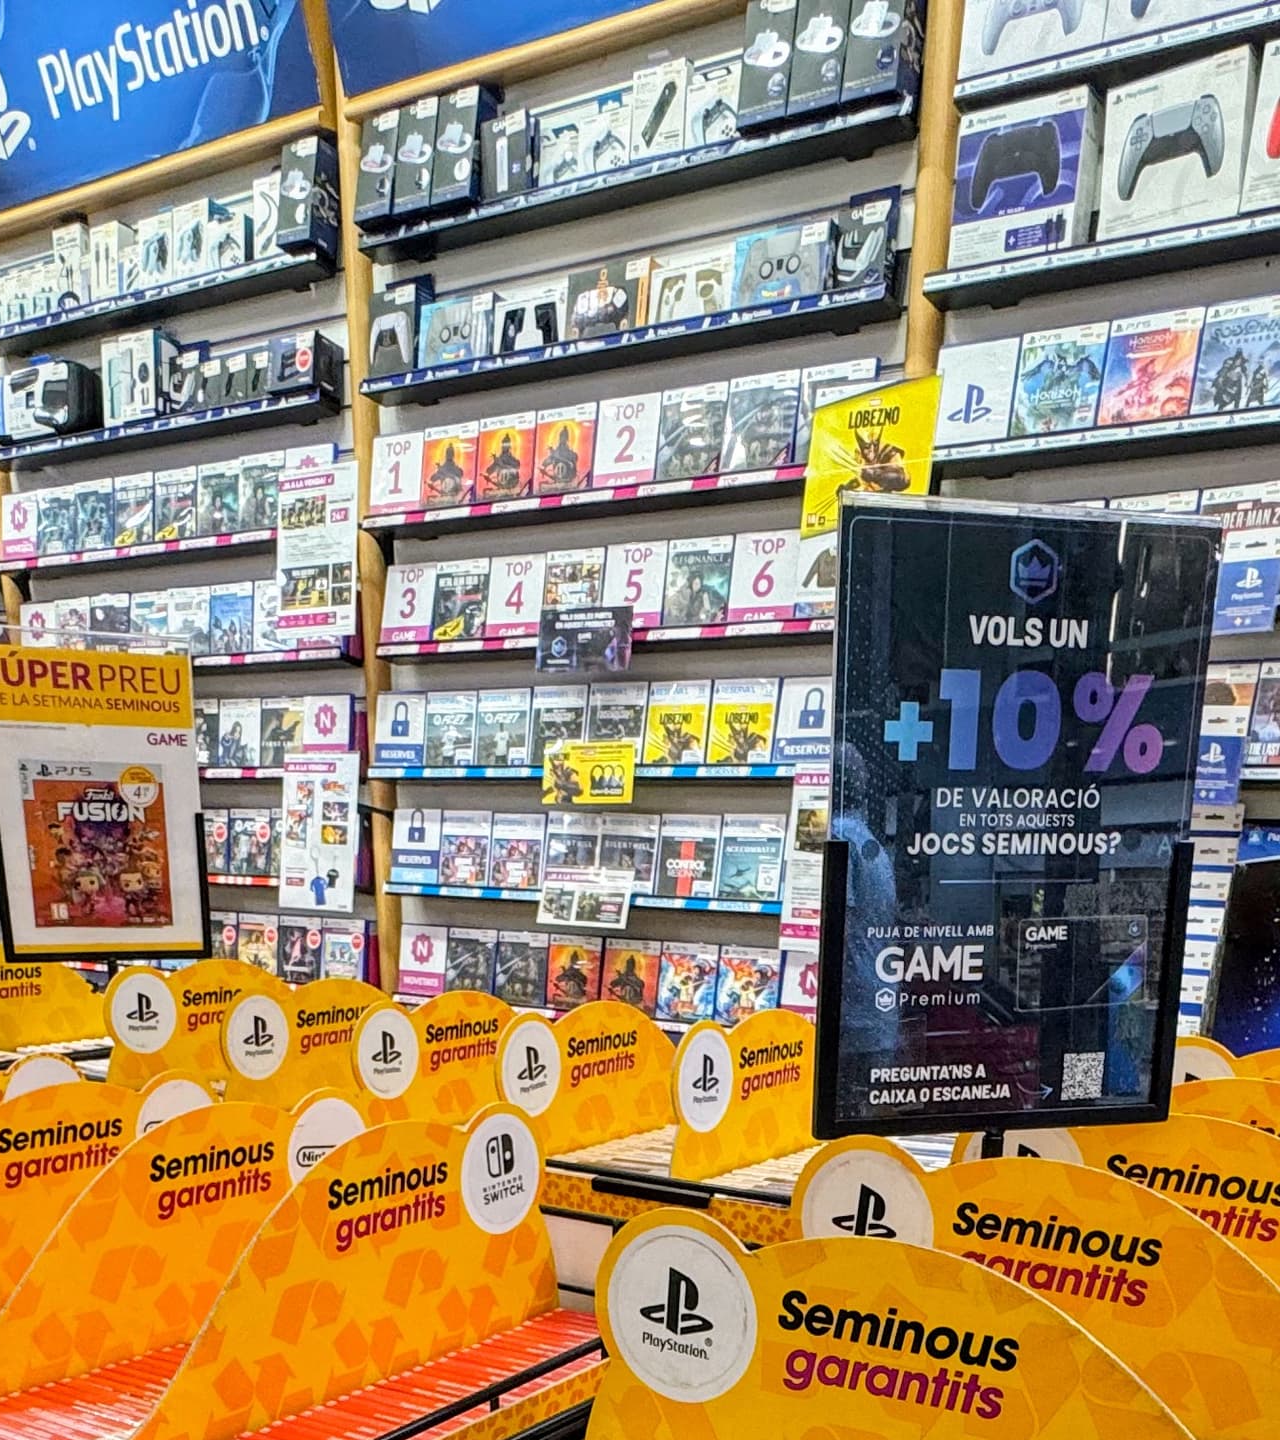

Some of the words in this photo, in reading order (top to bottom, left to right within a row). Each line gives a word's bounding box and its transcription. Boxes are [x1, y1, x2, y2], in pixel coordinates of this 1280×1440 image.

[614, 402, 645, 421] TOP
[849, 406, 900, 428] LOBEZNO
[387, 441, 411, 456] TOP
[614, 427, 636, 463] 2
[388, 461, 402, 494] 1
[624, 548, 653, 563] TOP
[752, 538, 786, 555] TOP
[400, 569, 423, 583] TOP
[505, 561, 533, 576] TOP
[752, 560, 774, 598] 6
[505, 581, 524, 614] 4
[624, 569, 643, 602] 5
[400, 588, 417, 619] 3
[969, 615, 1043, 648] VOLS
[1050, 618, 1088, 649] UN
[98, 664, 180, 694] PREU
[10, 692, 29, 706] LA
[33, 693, 104, 709] SETMANA
[106, 696, 180, 713] SEMINOUS
[884, 669, 1163, 775] +10%
[146, 732, 188, 747] GAME
[55, 765, 93, 777] PS5
[937, 788, 963, 809] DE
[972, 784, 1100, 809] VALORACIÓ
[57, 801, 145, 823] FUSION
[959, 813, 976, 827] EN
[980, 813, 1013, 827] TOTS
[1017, 813, 1075, 829] AQUESTS
[907, 833, 975, 855] JOCS
[982, 832, 1121, 855] SEMINOUS?
[868, 927, 900, 938] PUJA
[903, 926, 919, 937] DE
[923, 926, 963, 937] NIVELL
[966, 925, 994, 937] AMB
[1025, 926, 1068, 941] GAME
[875, 945, 984, 983] GAME
[899, 990, 980, 1007] Premium
[425, 1016, 499, 1044] Seminous
[429, 1034, 498, 1071] garantits
[570, 1048, 636, 1086] garantits
[741, 1061, 800, 1099] garantits
[870, 1065, 972, 1083] PREGUNTA'NS
[975, 1064, 986, 1079] A
[869, 1087, 917, 1104] CAIXA
[920, 1086, 929, 1102] O
[933, 1084, 1010, 1101] ESCANEJA
[4, 1142, 121, 1189] garantits
[149, 1138, 275, 1183] Seminous
[158, 1167, 272, 1220] garantits
[328, 1161, 448, 1211] Seminous
[336, 1194, 446, 1252] garantits
[953, 1200, 1162, 1268] Seminous
[779, 1290, 1019, 1372] Seminous
[642, 1332, 710, 1361] PlayStation
[782, 1344, 1004, 1420] garantits
